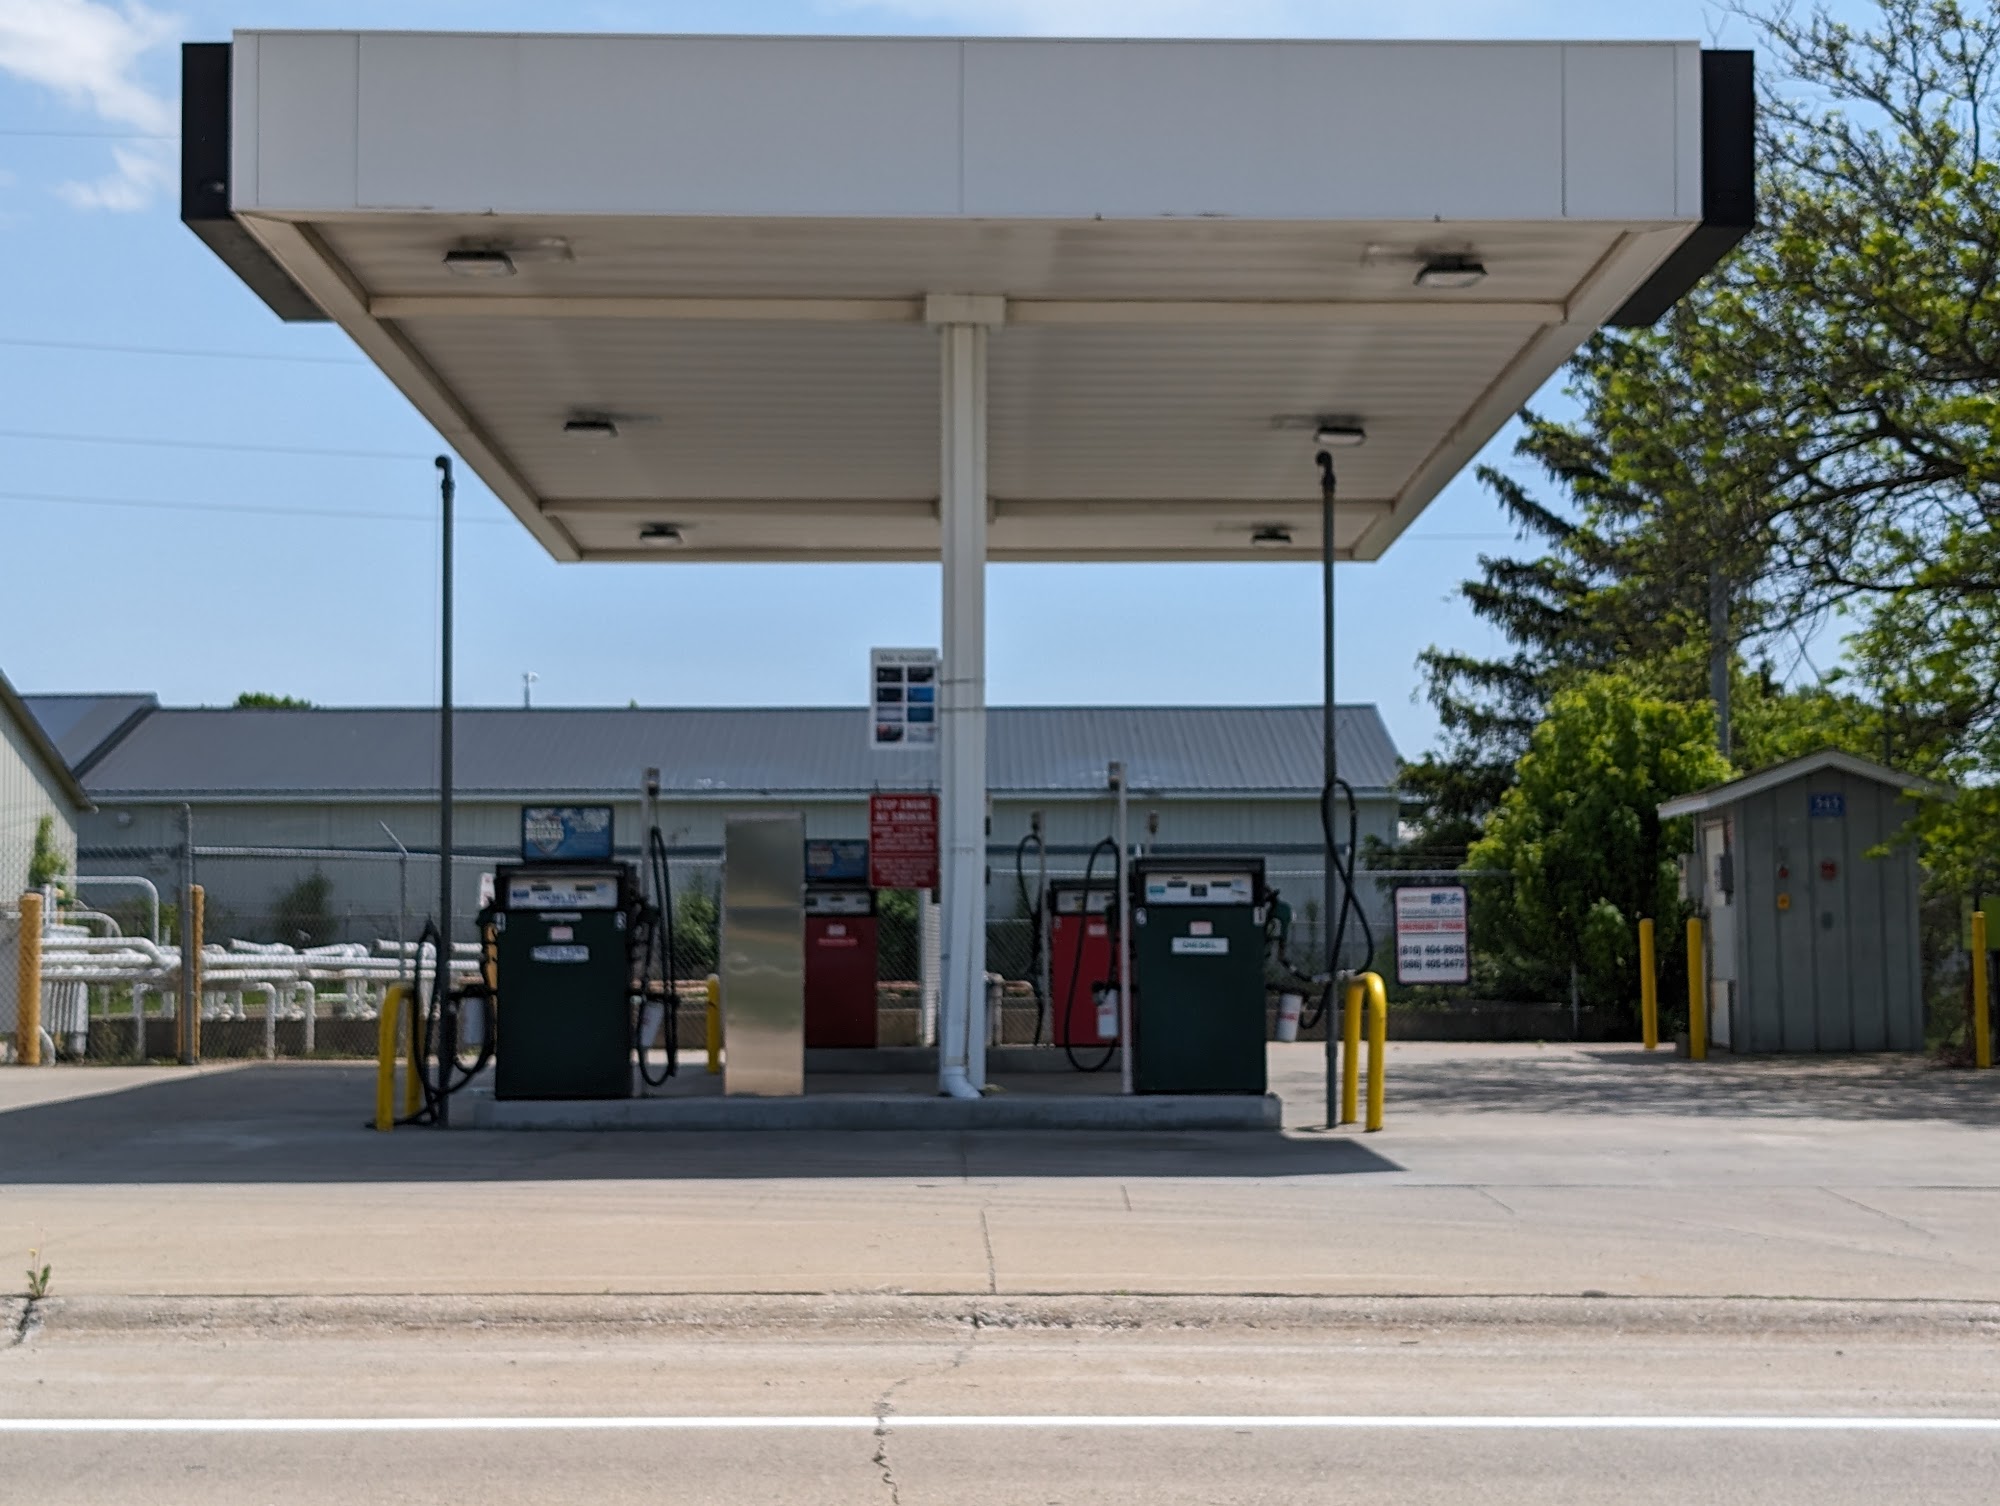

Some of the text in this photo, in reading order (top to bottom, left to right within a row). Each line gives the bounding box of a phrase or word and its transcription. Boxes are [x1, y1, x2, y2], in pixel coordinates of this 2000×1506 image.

[875, 798, 932, 810] STOP ENGINE
[875, 810, 932, 821] NO SMOKING
